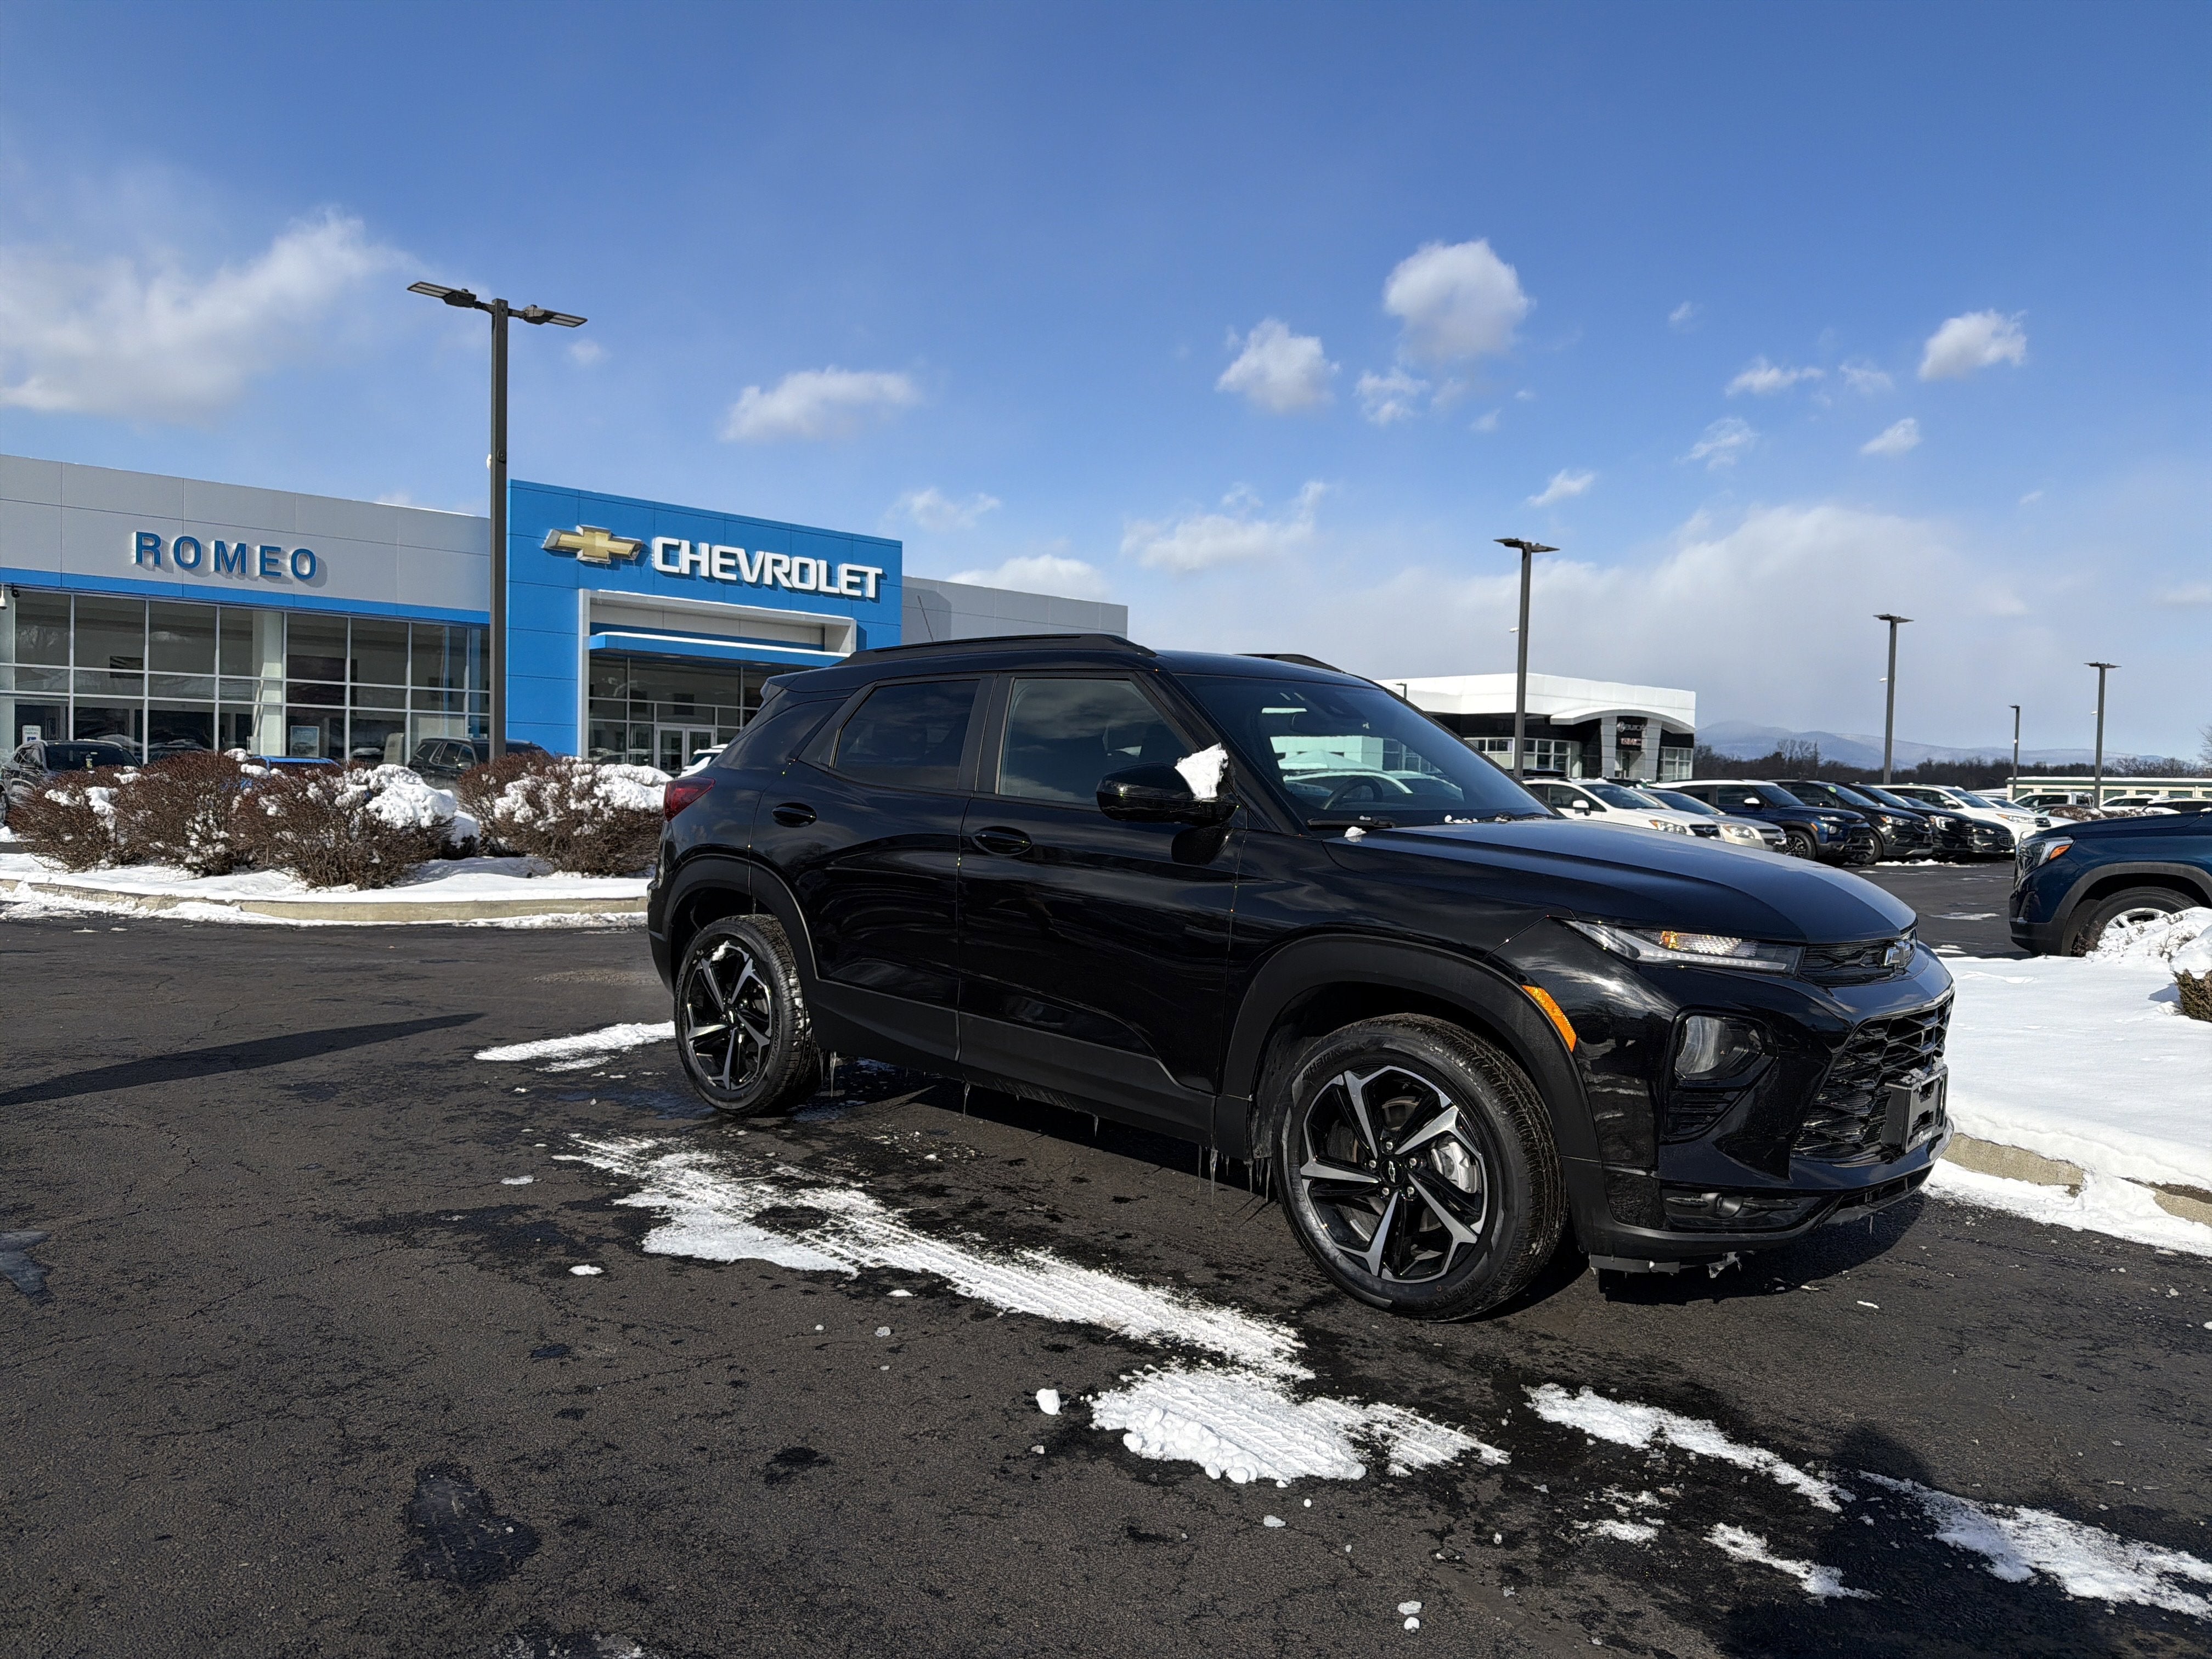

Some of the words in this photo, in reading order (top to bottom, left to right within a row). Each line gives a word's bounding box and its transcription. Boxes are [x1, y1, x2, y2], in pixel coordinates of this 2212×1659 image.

[135, 531, 317, 580] ROMEO
[653, 537, 883, 598] CHEVROLET
[1621, 737, 1642, 746] GMC
